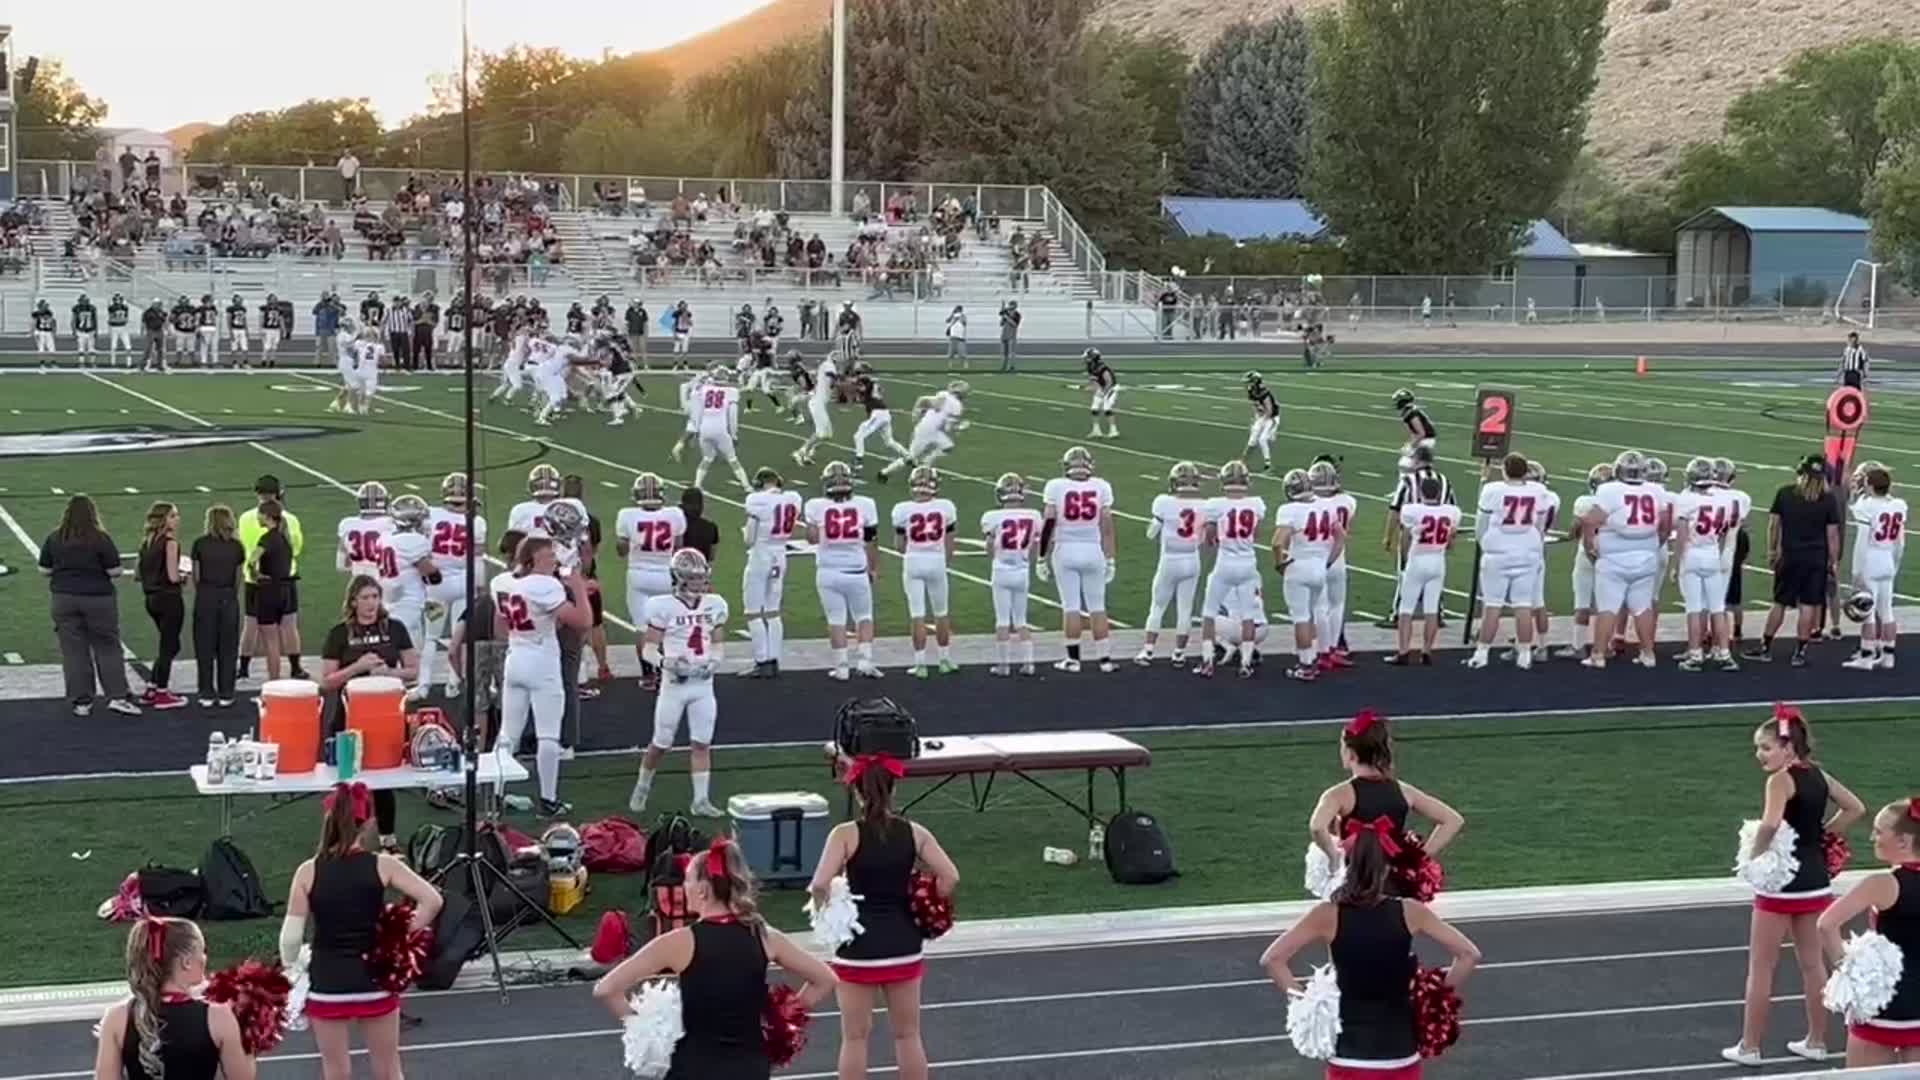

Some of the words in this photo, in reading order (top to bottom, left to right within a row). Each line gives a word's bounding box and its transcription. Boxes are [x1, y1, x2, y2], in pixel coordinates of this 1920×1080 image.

[1480, 396, 1509, 433] 2
[771, 504, 796, 535] 18
[1063, 491, 1098, 520] 65
[1502, 496, 1535, 525] 77
[1624, 495, 1656, 526] 79
[637, 521, 673, 551] 72
[824, 508, 859, 538] 62
[910, 512, 944, 542] 23
[1002, 519, 1034, 549] 27
[1178, 509, 1196, 537] 3
[1226, 509, 1255, 538] 19
[1304, 511, 1330, 541] 44
[1418, 515, 1452, 545] 26
[1876, 512, 1903, 541] 36
[348, 530, 382, 562] 30
[431, 521, 468, 557] 25
[497, 592, 535, 632] 52
[676, 614, 712, 625] UTES
[688, 626, 705, 655] 4
